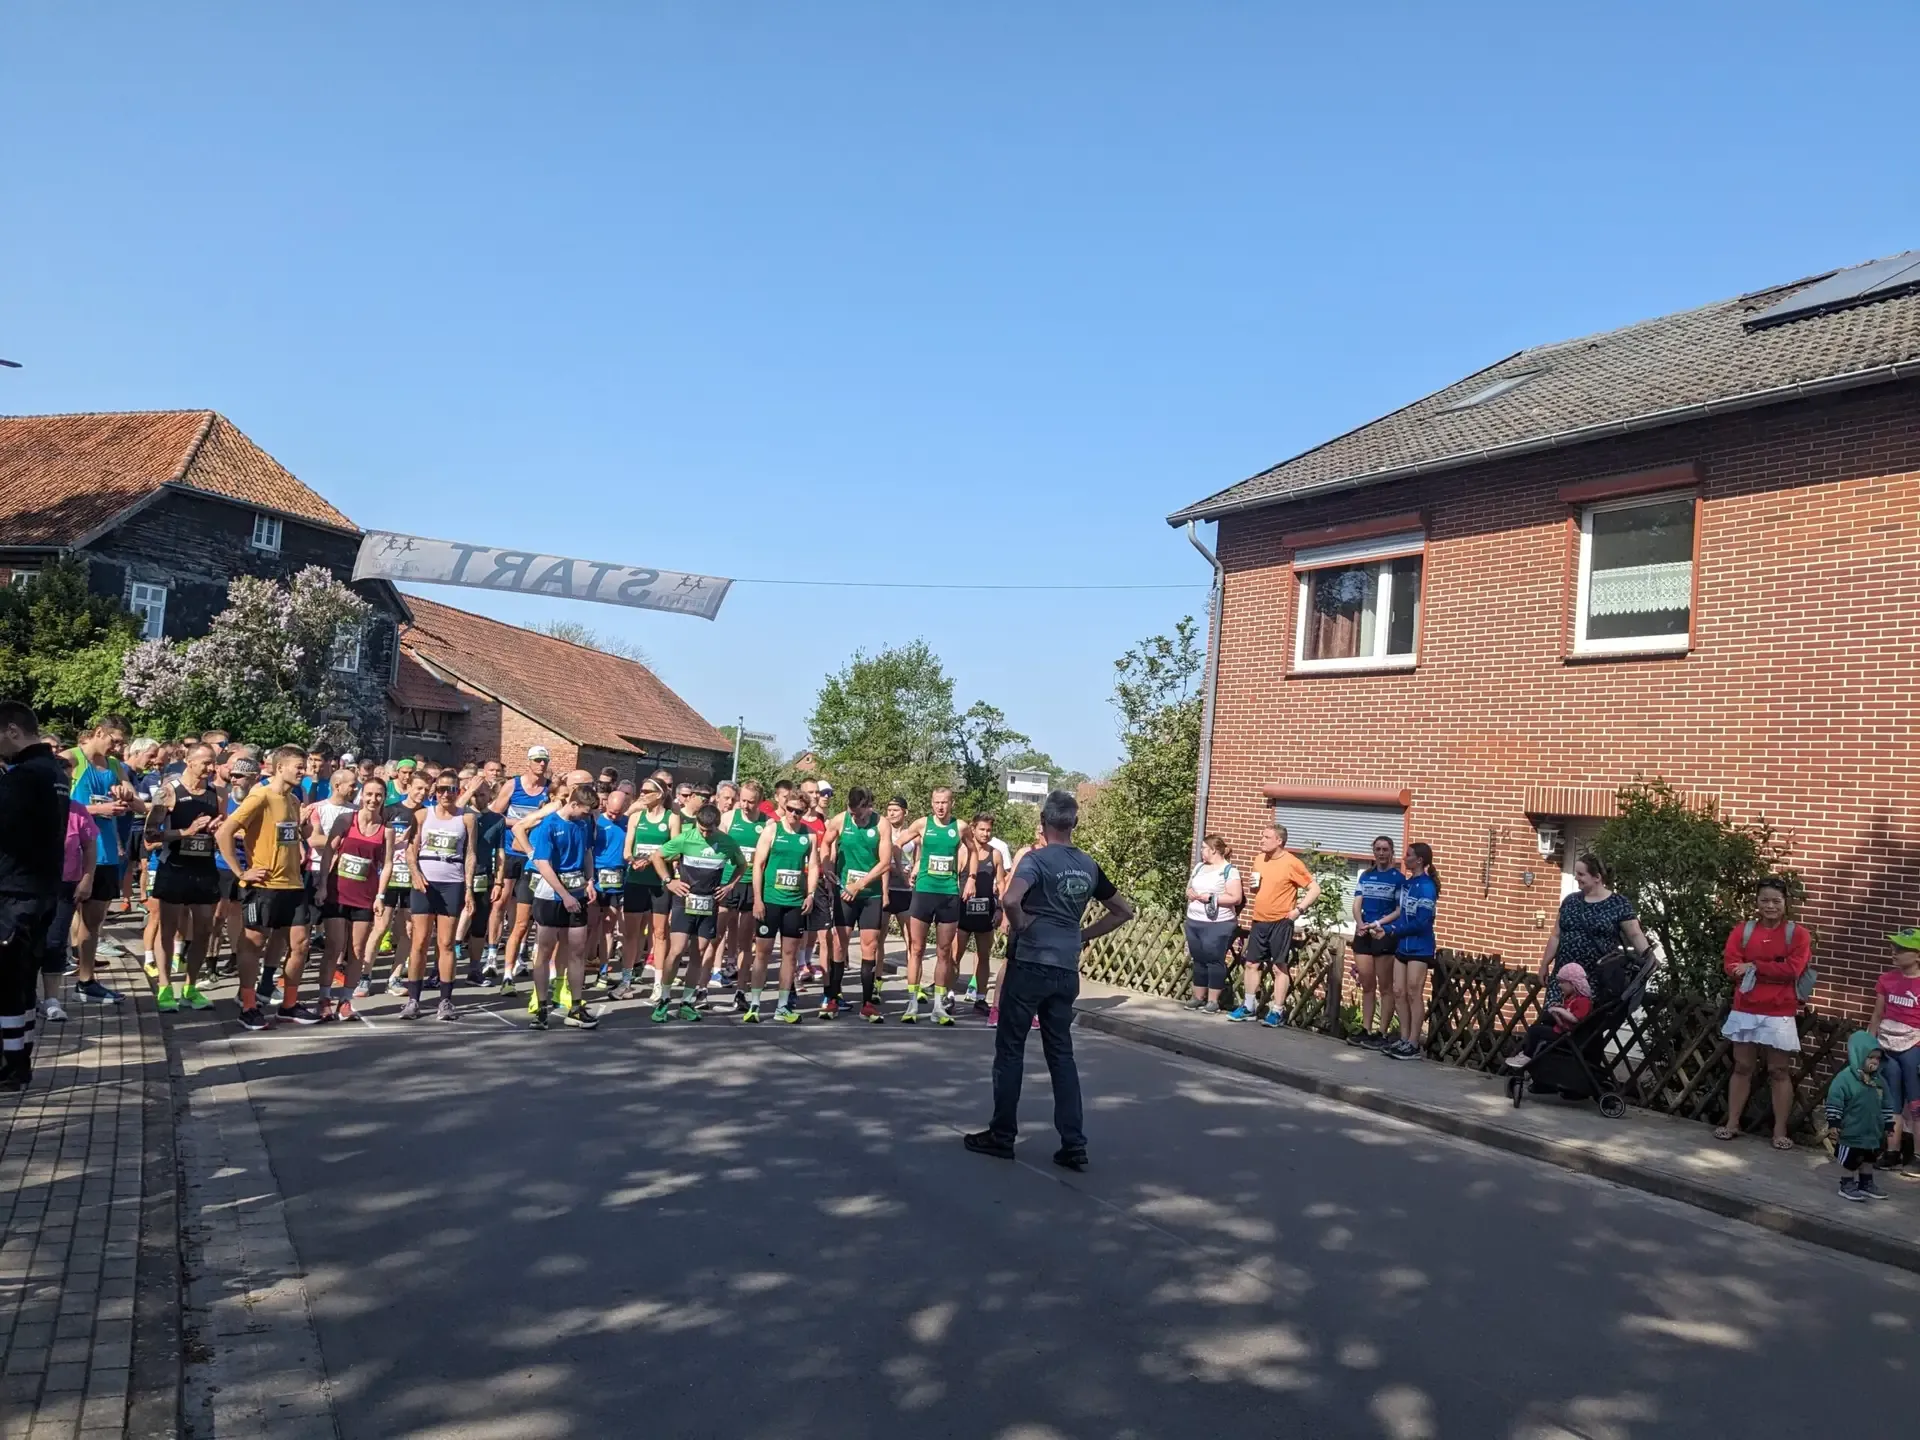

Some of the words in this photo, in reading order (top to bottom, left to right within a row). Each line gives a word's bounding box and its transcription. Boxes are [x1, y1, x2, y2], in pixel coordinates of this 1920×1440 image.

[283, 829, 295, 840] 28
[190, 840, 205, 851] 36
[433, 836, 449, 848] 30
[344, 861, 361, 875] 29
[931, 861, 949, 871] 183
[395, 872, 410, 883] 38
[606, 875, 618, 884] 48
[781, 875, 798, 886] 103
[690, 899, 709, 910] 126
[1888, 994, 1914, 1008] PUMA
